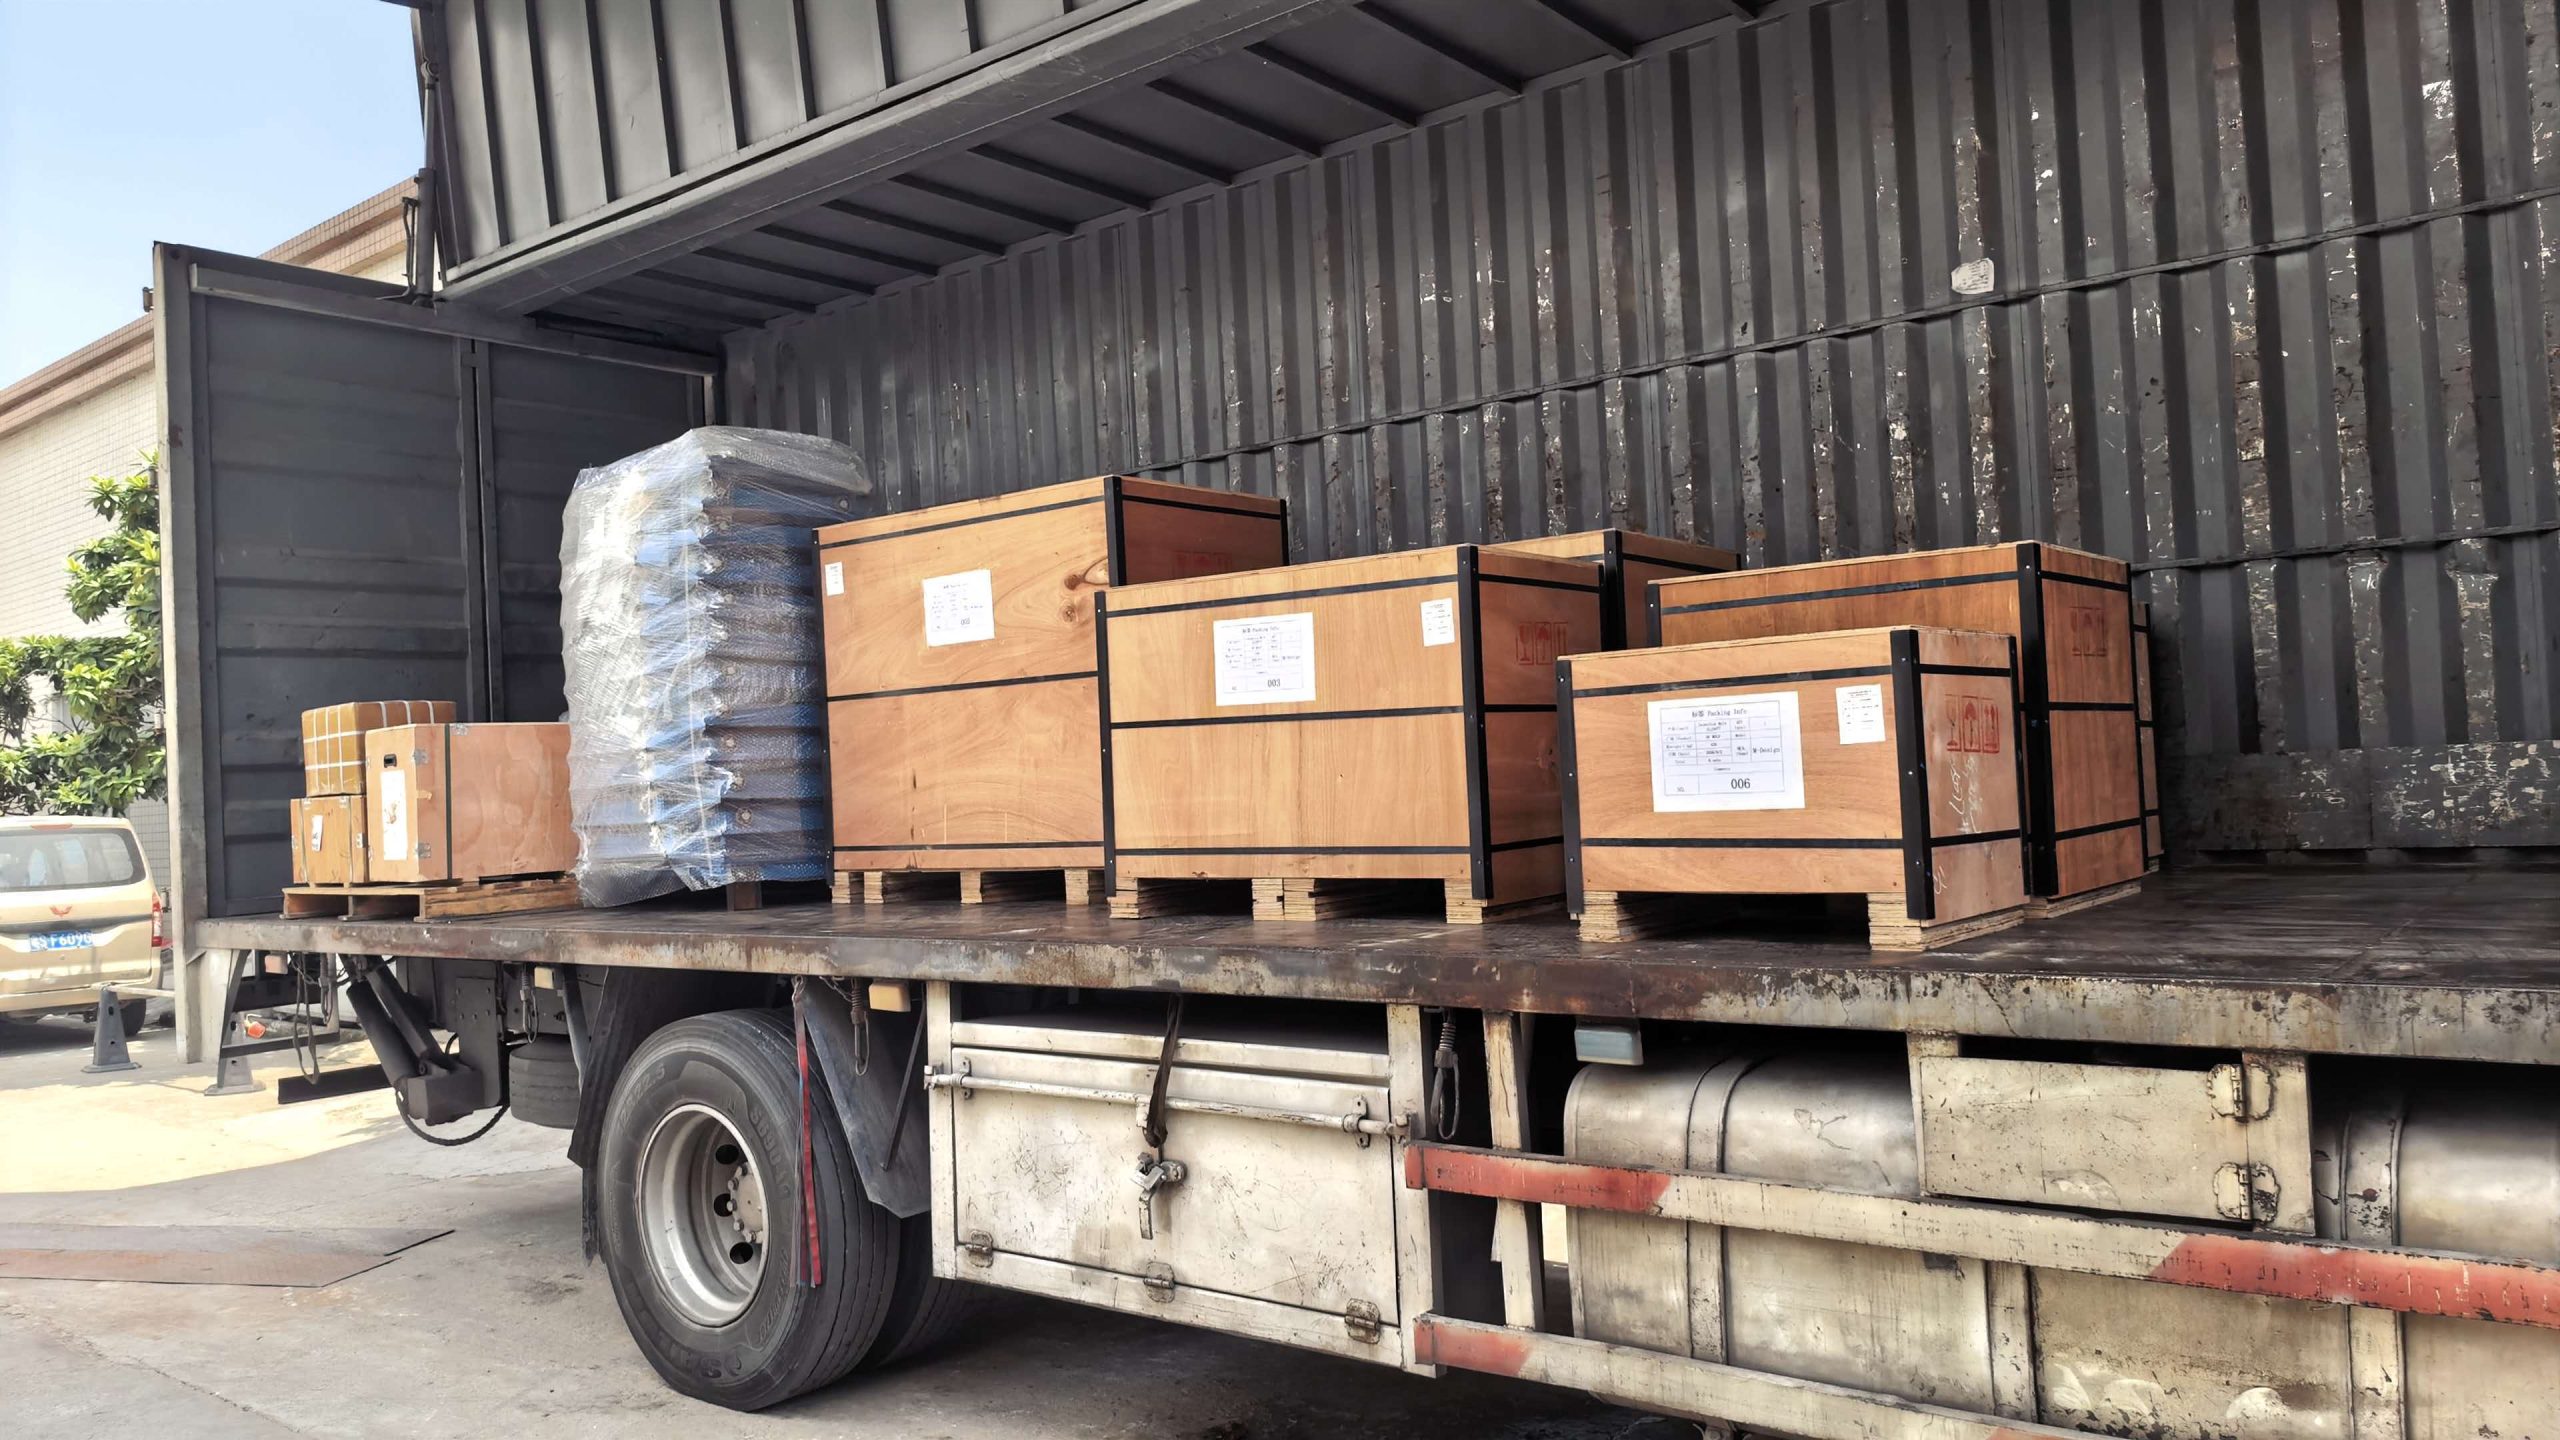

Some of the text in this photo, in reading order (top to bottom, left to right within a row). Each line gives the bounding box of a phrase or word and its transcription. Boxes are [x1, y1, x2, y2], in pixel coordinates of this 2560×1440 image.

[1267, 678, 1281, 688] 003
[1707, 709, 1731, 717] Packing
[1730, 777, 1751, 789] 006
